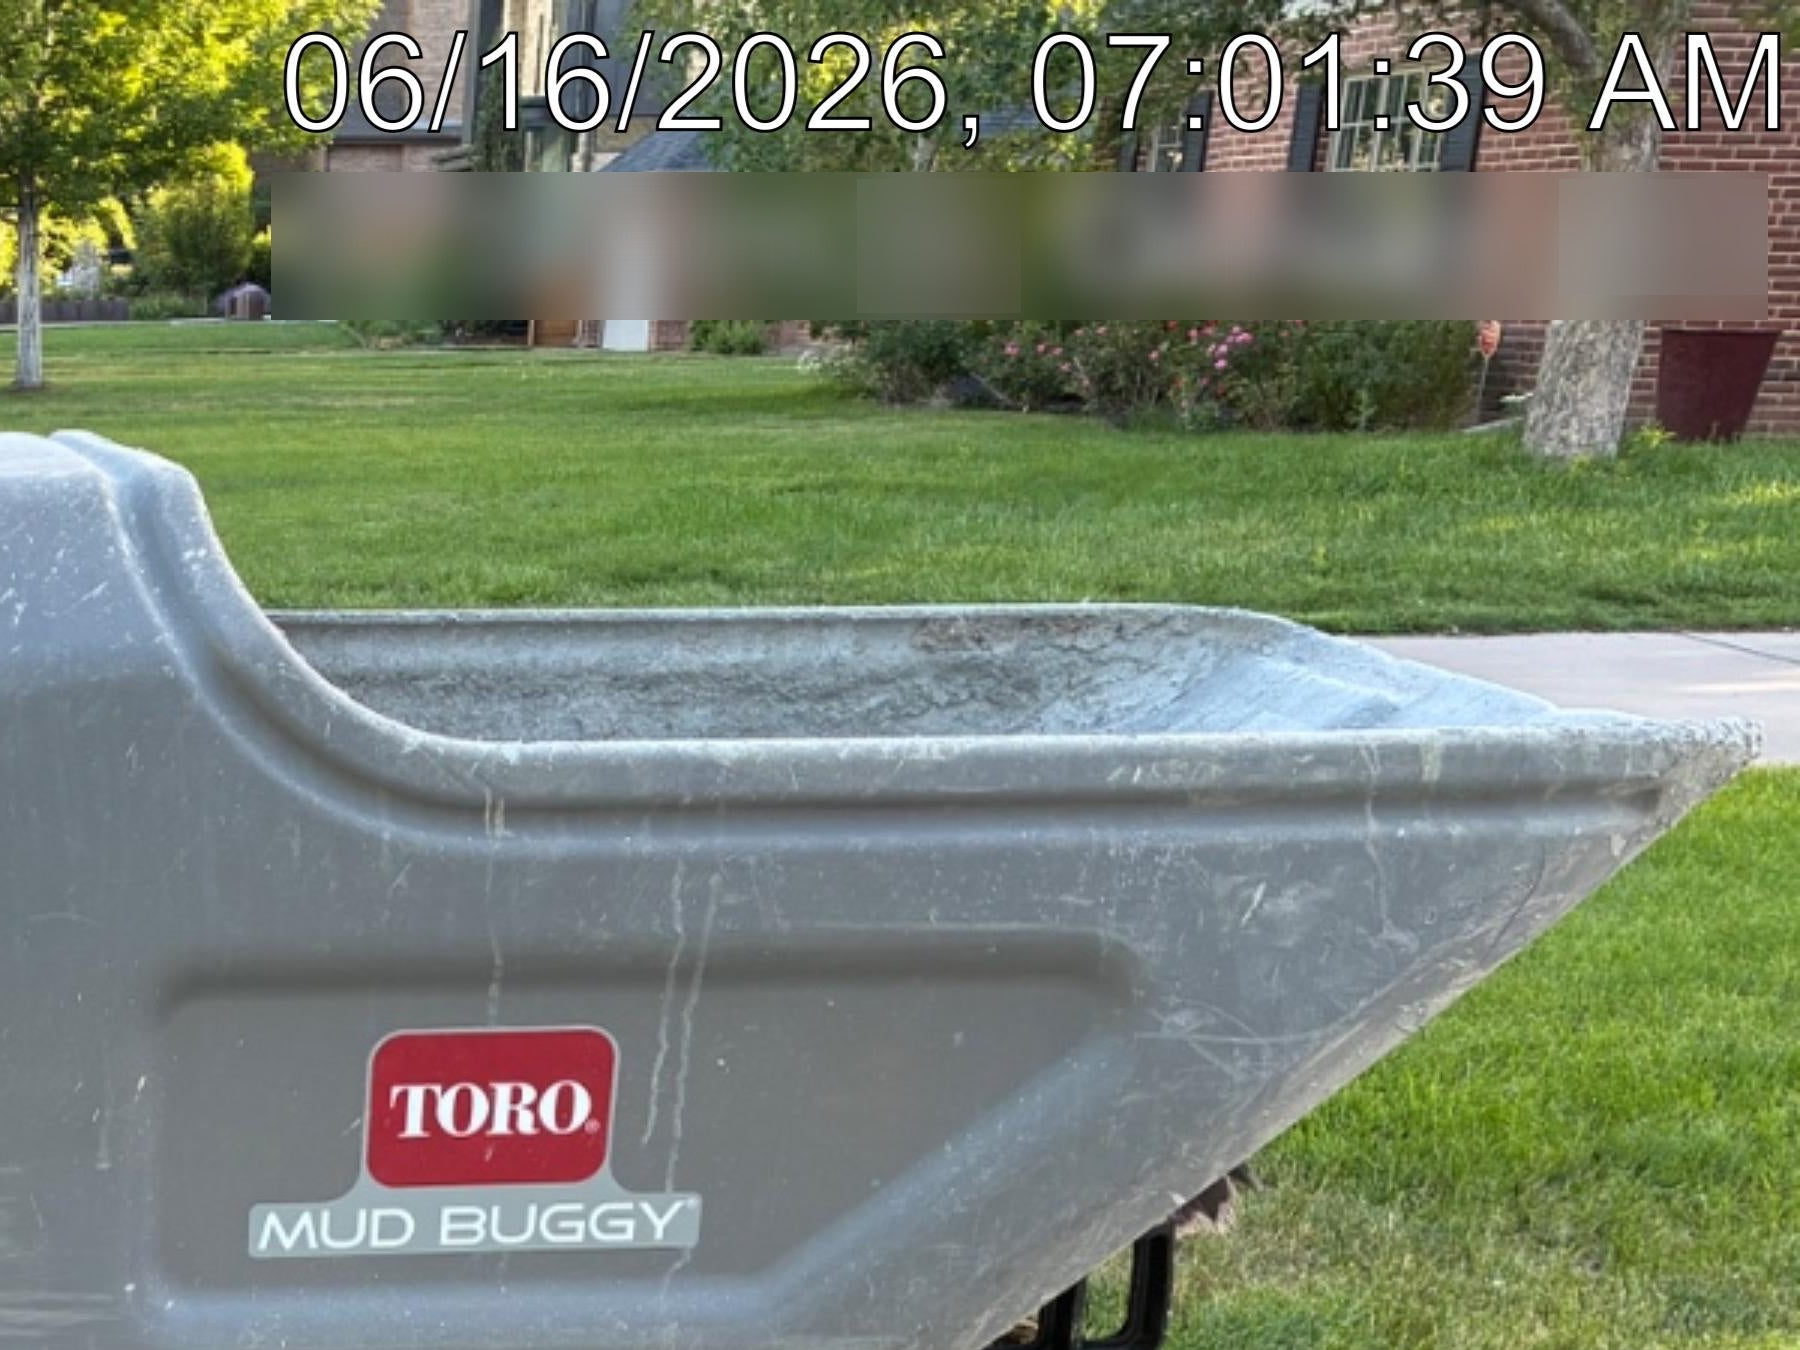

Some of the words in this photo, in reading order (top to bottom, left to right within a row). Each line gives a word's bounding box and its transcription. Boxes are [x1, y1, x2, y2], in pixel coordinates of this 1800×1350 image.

[390, 1080, 592, 1139] TORO
[258, 1207, 415, 1252] MUD
[439, 1201, 688, 1247] BUGGY
